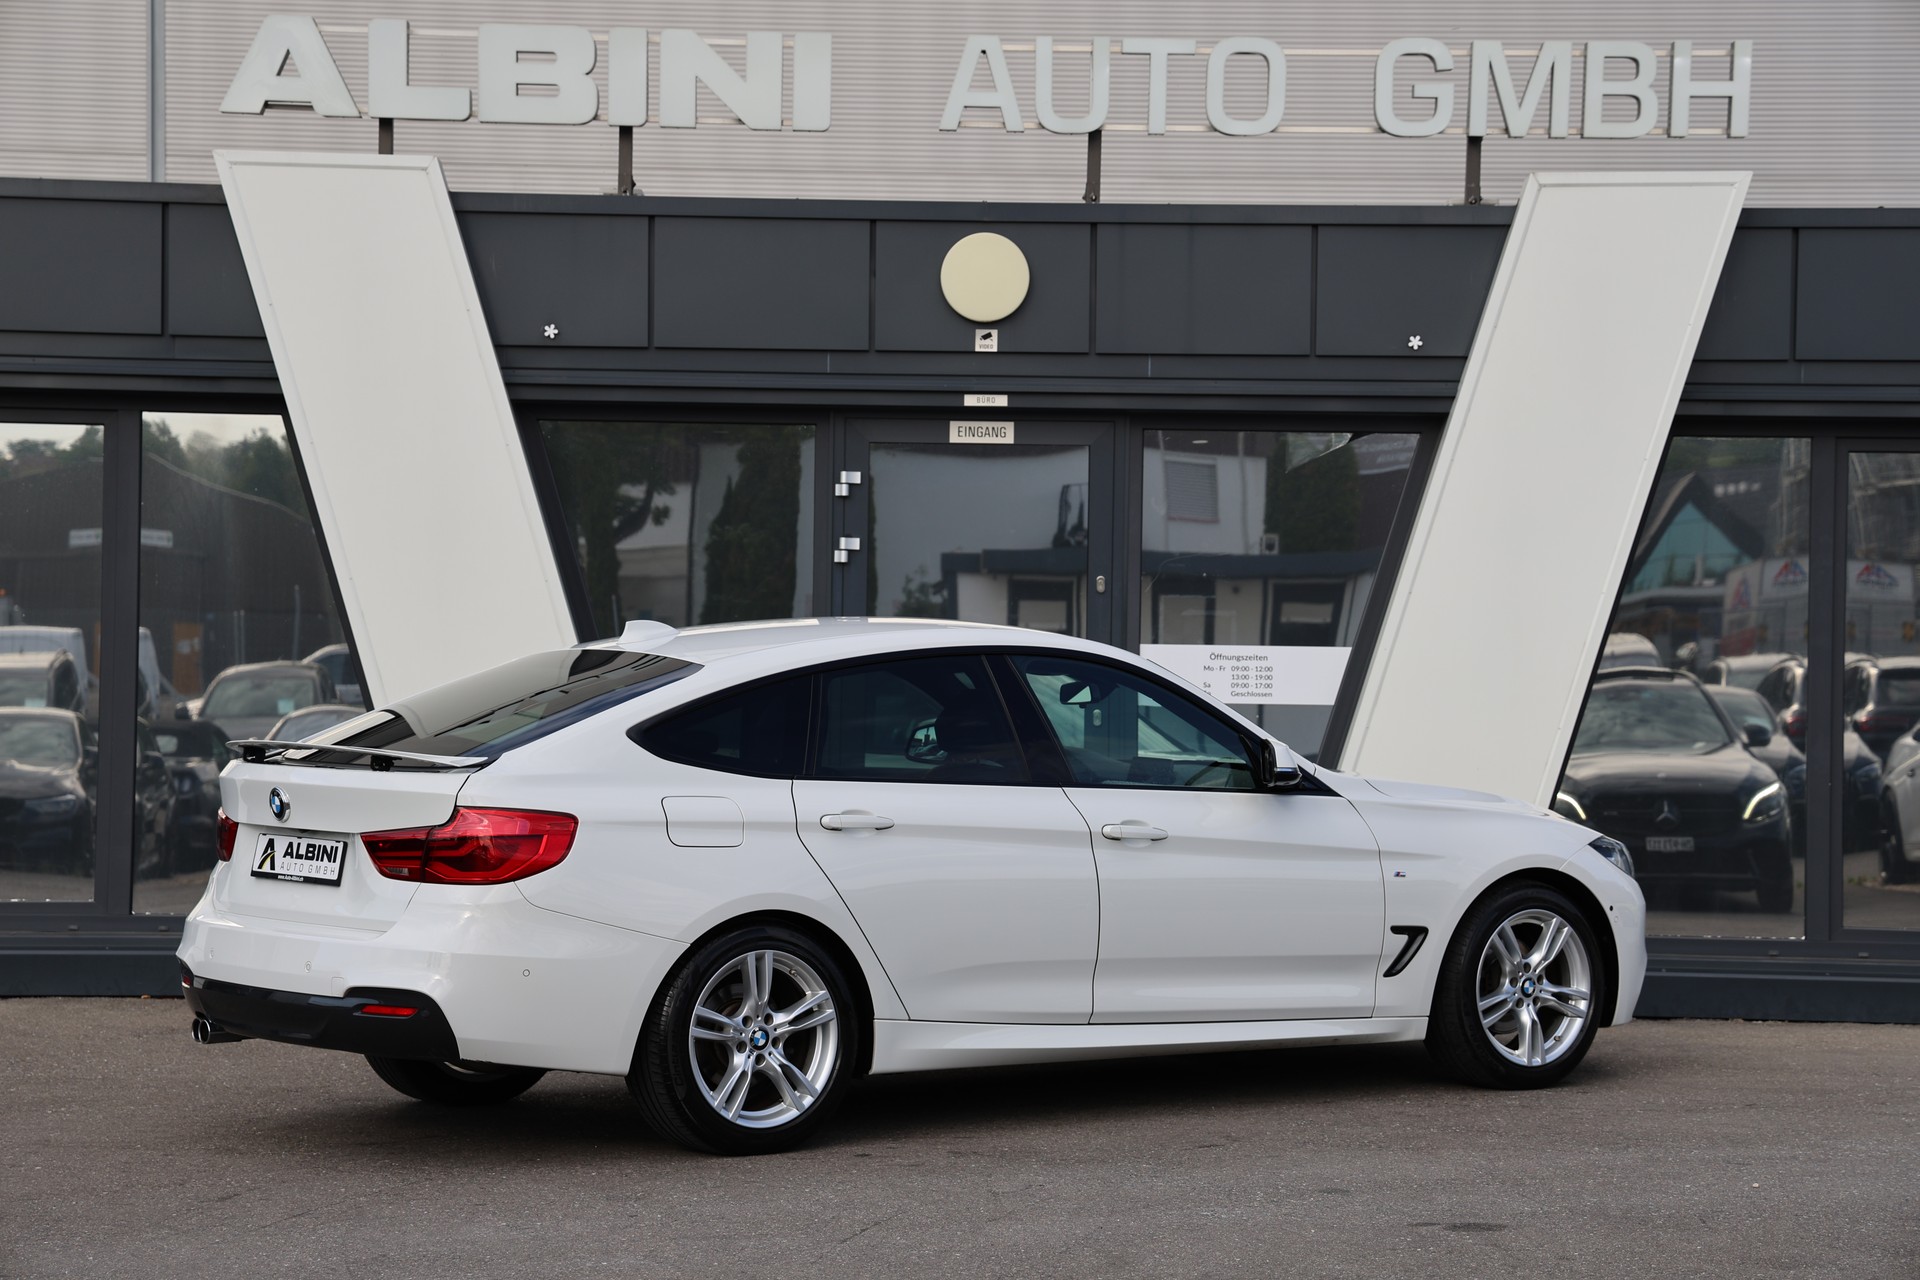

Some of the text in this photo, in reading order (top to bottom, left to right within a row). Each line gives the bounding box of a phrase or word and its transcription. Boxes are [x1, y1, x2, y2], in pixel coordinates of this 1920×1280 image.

[219, 14, 1753, 139] ALBINI AUTO GMBH
[976, 396, 996, 404] BÜRO
[957, 425, 1007, 439] EINGANG
[1209, 652, 1268, 662] Öffnungszeiten
[282, 841, 339, 864] ALBINI
[280, 861, 336, 876] AUTO GMBH
